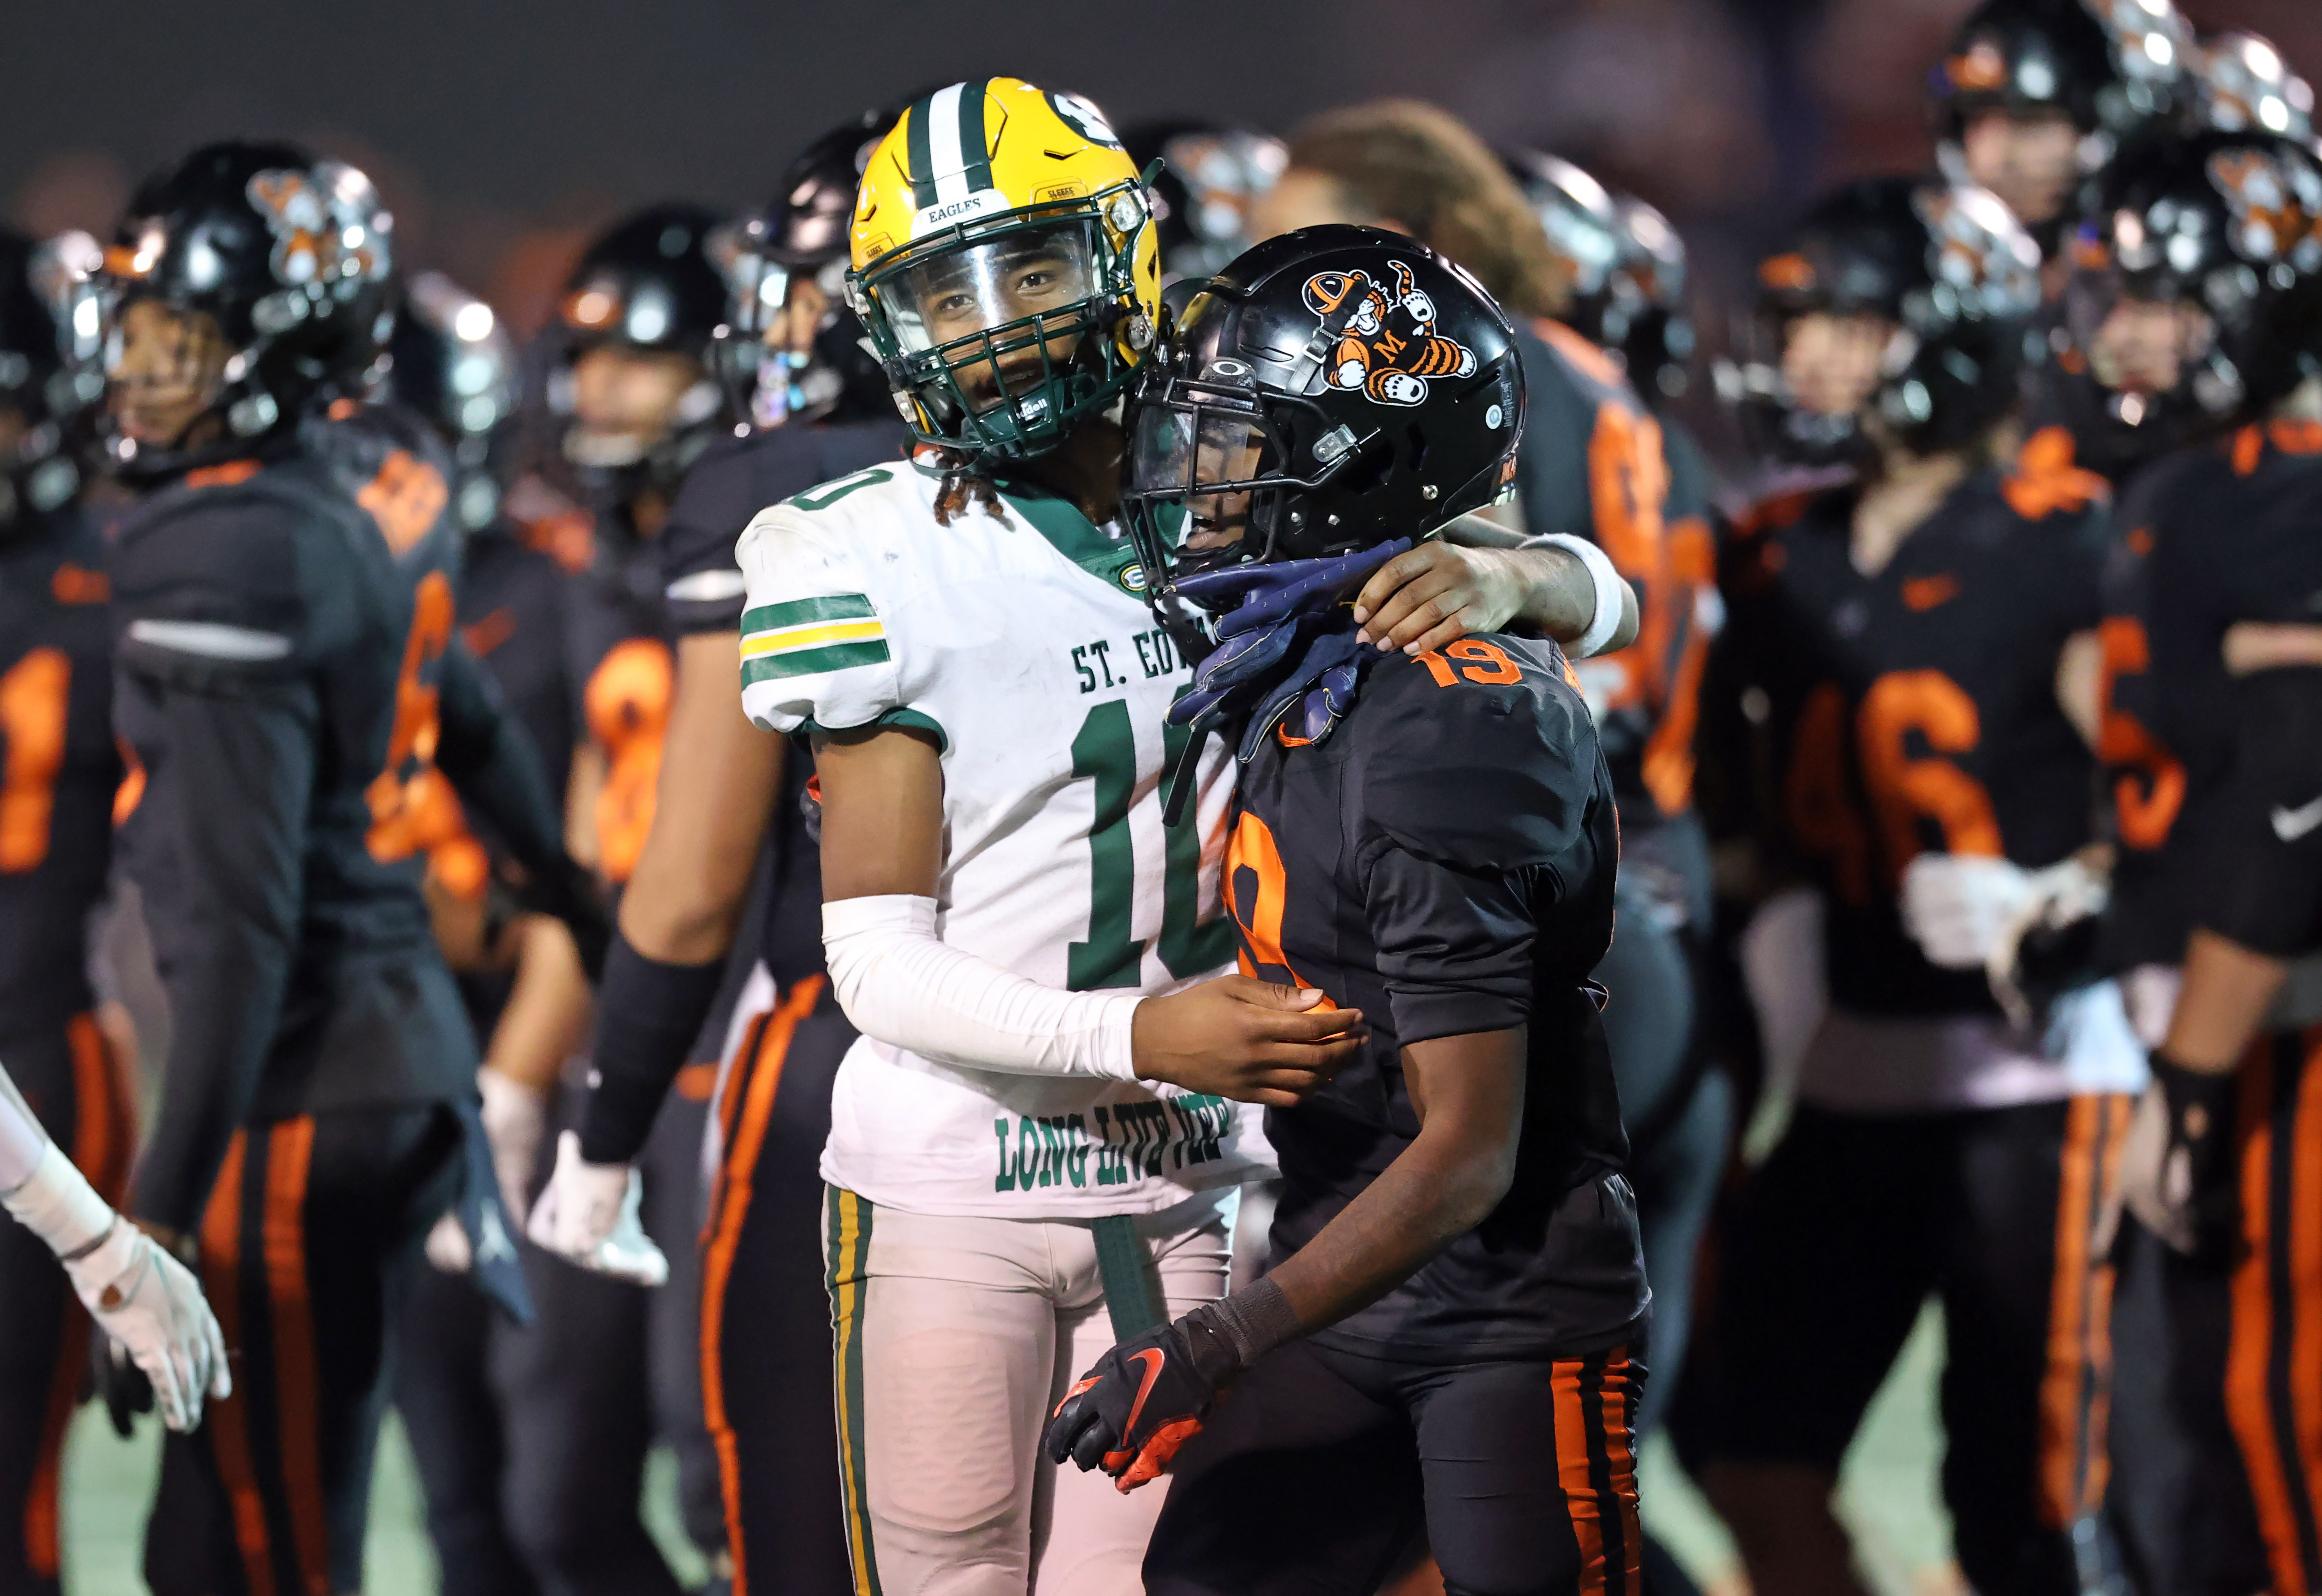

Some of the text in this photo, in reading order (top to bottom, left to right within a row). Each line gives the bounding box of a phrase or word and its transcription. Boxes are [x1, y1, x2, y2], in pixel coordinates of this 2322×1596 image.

[928, 198, 981, 223] EAGLES
[1373, 329, 1407, 365] M
[1070, 640, 1126, 694] ST.
[1410, 639, 1524, 689] 19
[995, 1113, 1087, 1191] LONG
